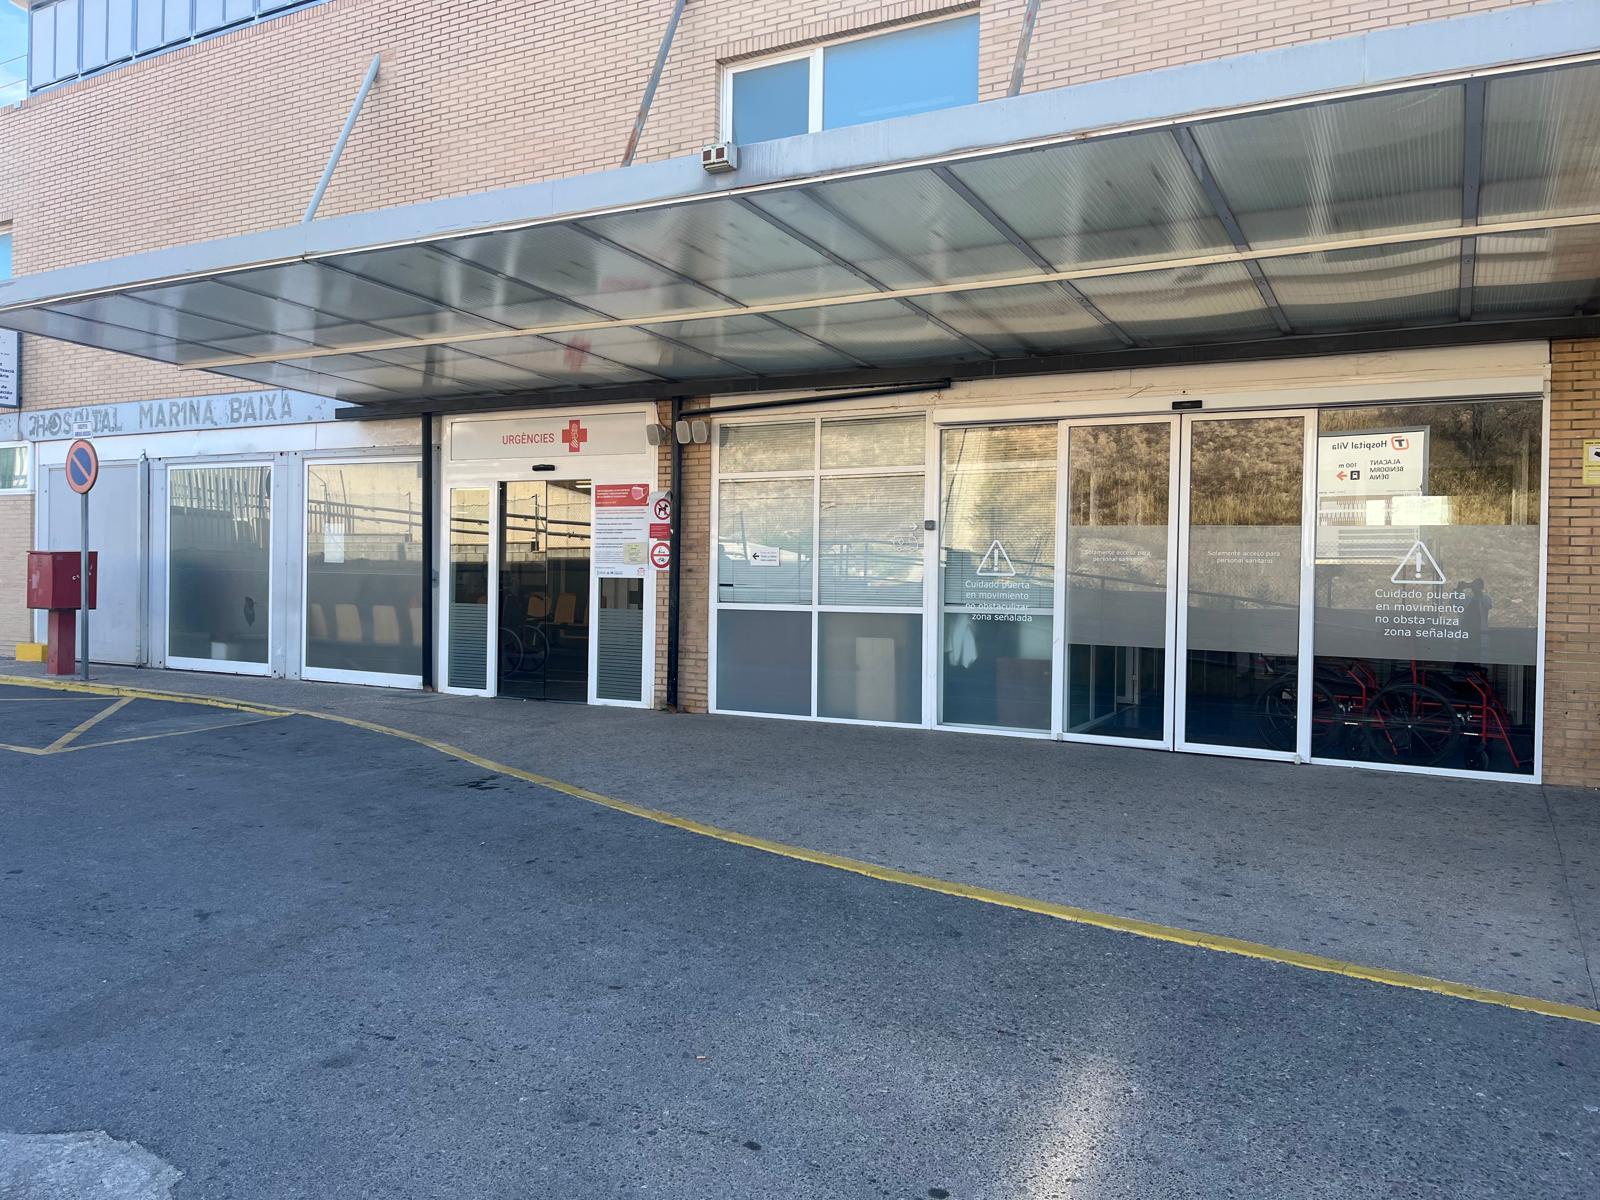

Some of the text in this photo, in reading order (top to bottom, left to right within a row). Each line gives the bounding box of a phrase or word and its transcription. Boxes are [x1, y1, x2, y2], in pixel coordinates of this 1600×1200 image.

[139, 399, 214, 428] MARINA
[230, 393, 292, 424] BAIXA
[965, 580, 1030, 590] Cuidado puerta
[979, 592, 1029, 600] movimiento
[1375, 588, 1466, 601] Cuidado puerta
[1375, 603, 1465, 613] en movimiento
[971, 613, 992, 621] zona
[1375, 614, 1459, 626] no obstauliza
[1383, 628, 1469, 639] zona señalada
